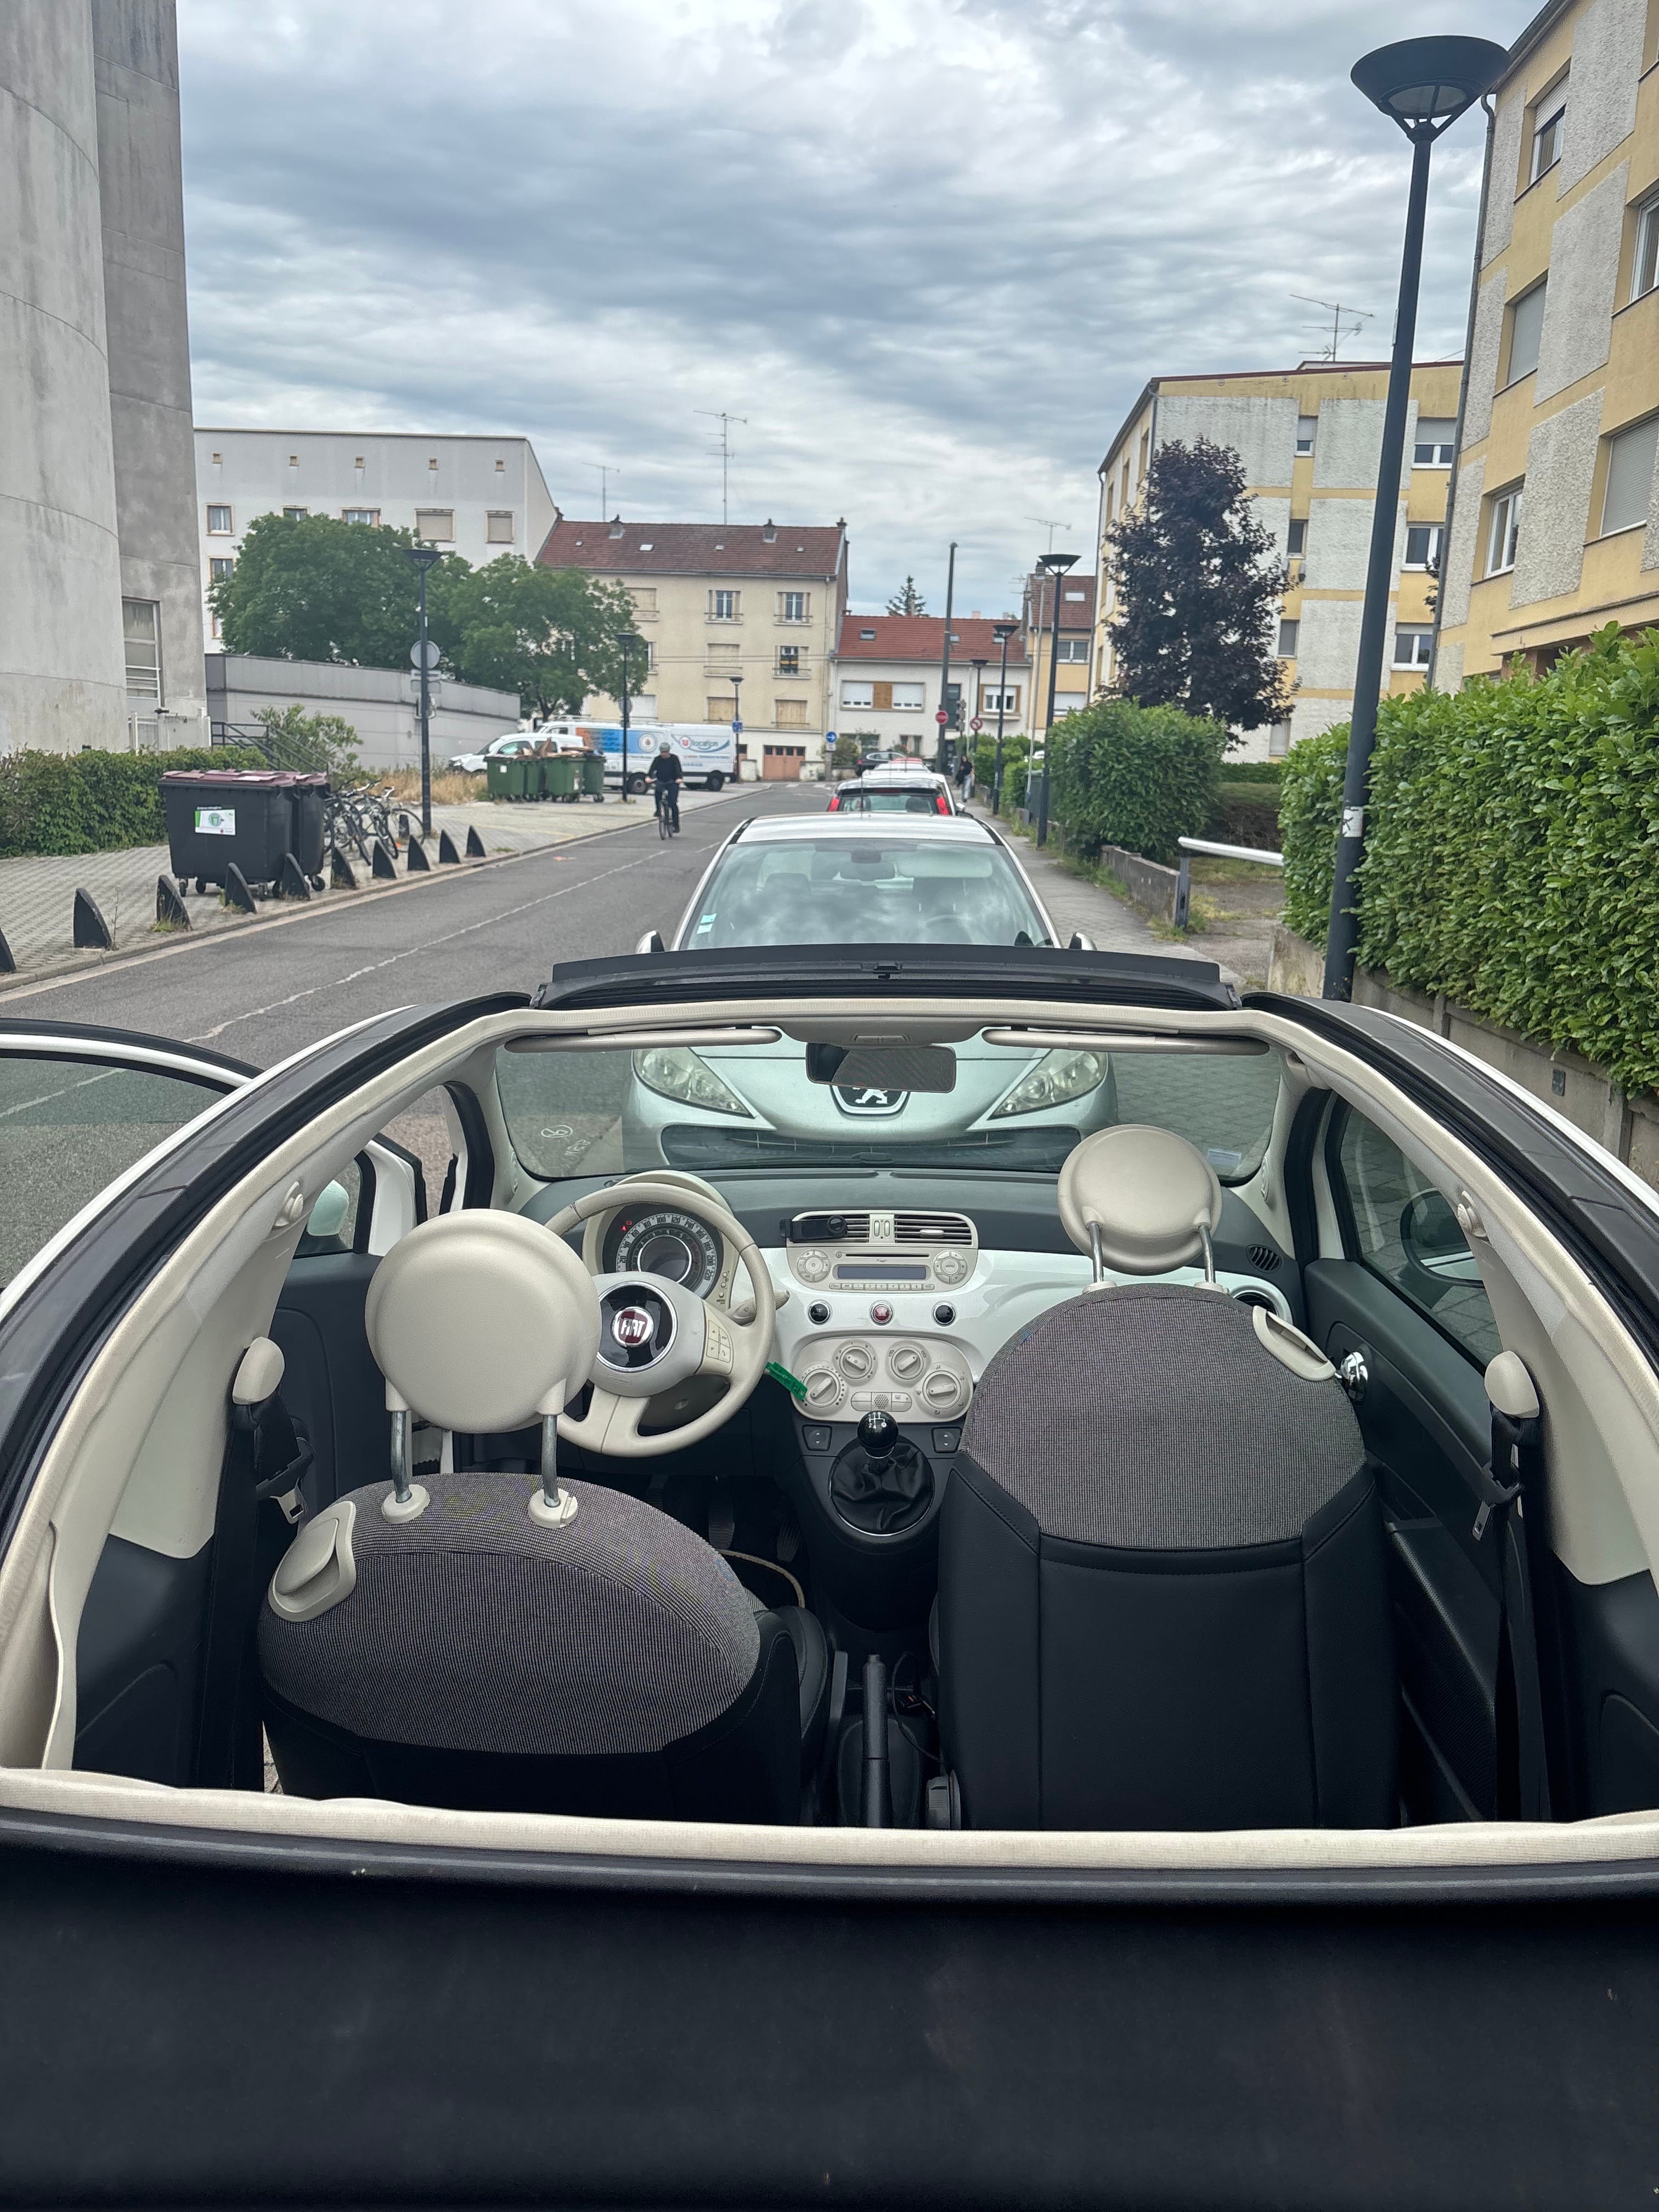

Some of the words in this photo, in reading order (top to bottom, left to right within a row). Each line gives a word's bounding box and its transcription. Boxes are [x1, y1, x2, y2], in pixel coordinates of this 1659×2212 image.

[643, 1220, 652, 1228] 80
[685, 1220, 695, 1230] 140
[631, 1229, 640, 1238] 60
[702, 1240, 712, 1251] 180
[619, 1255, 627, 1263] 20
[704, 1269, 713, 1281] 220
[620, 1318, 646, 1338] FIAT
